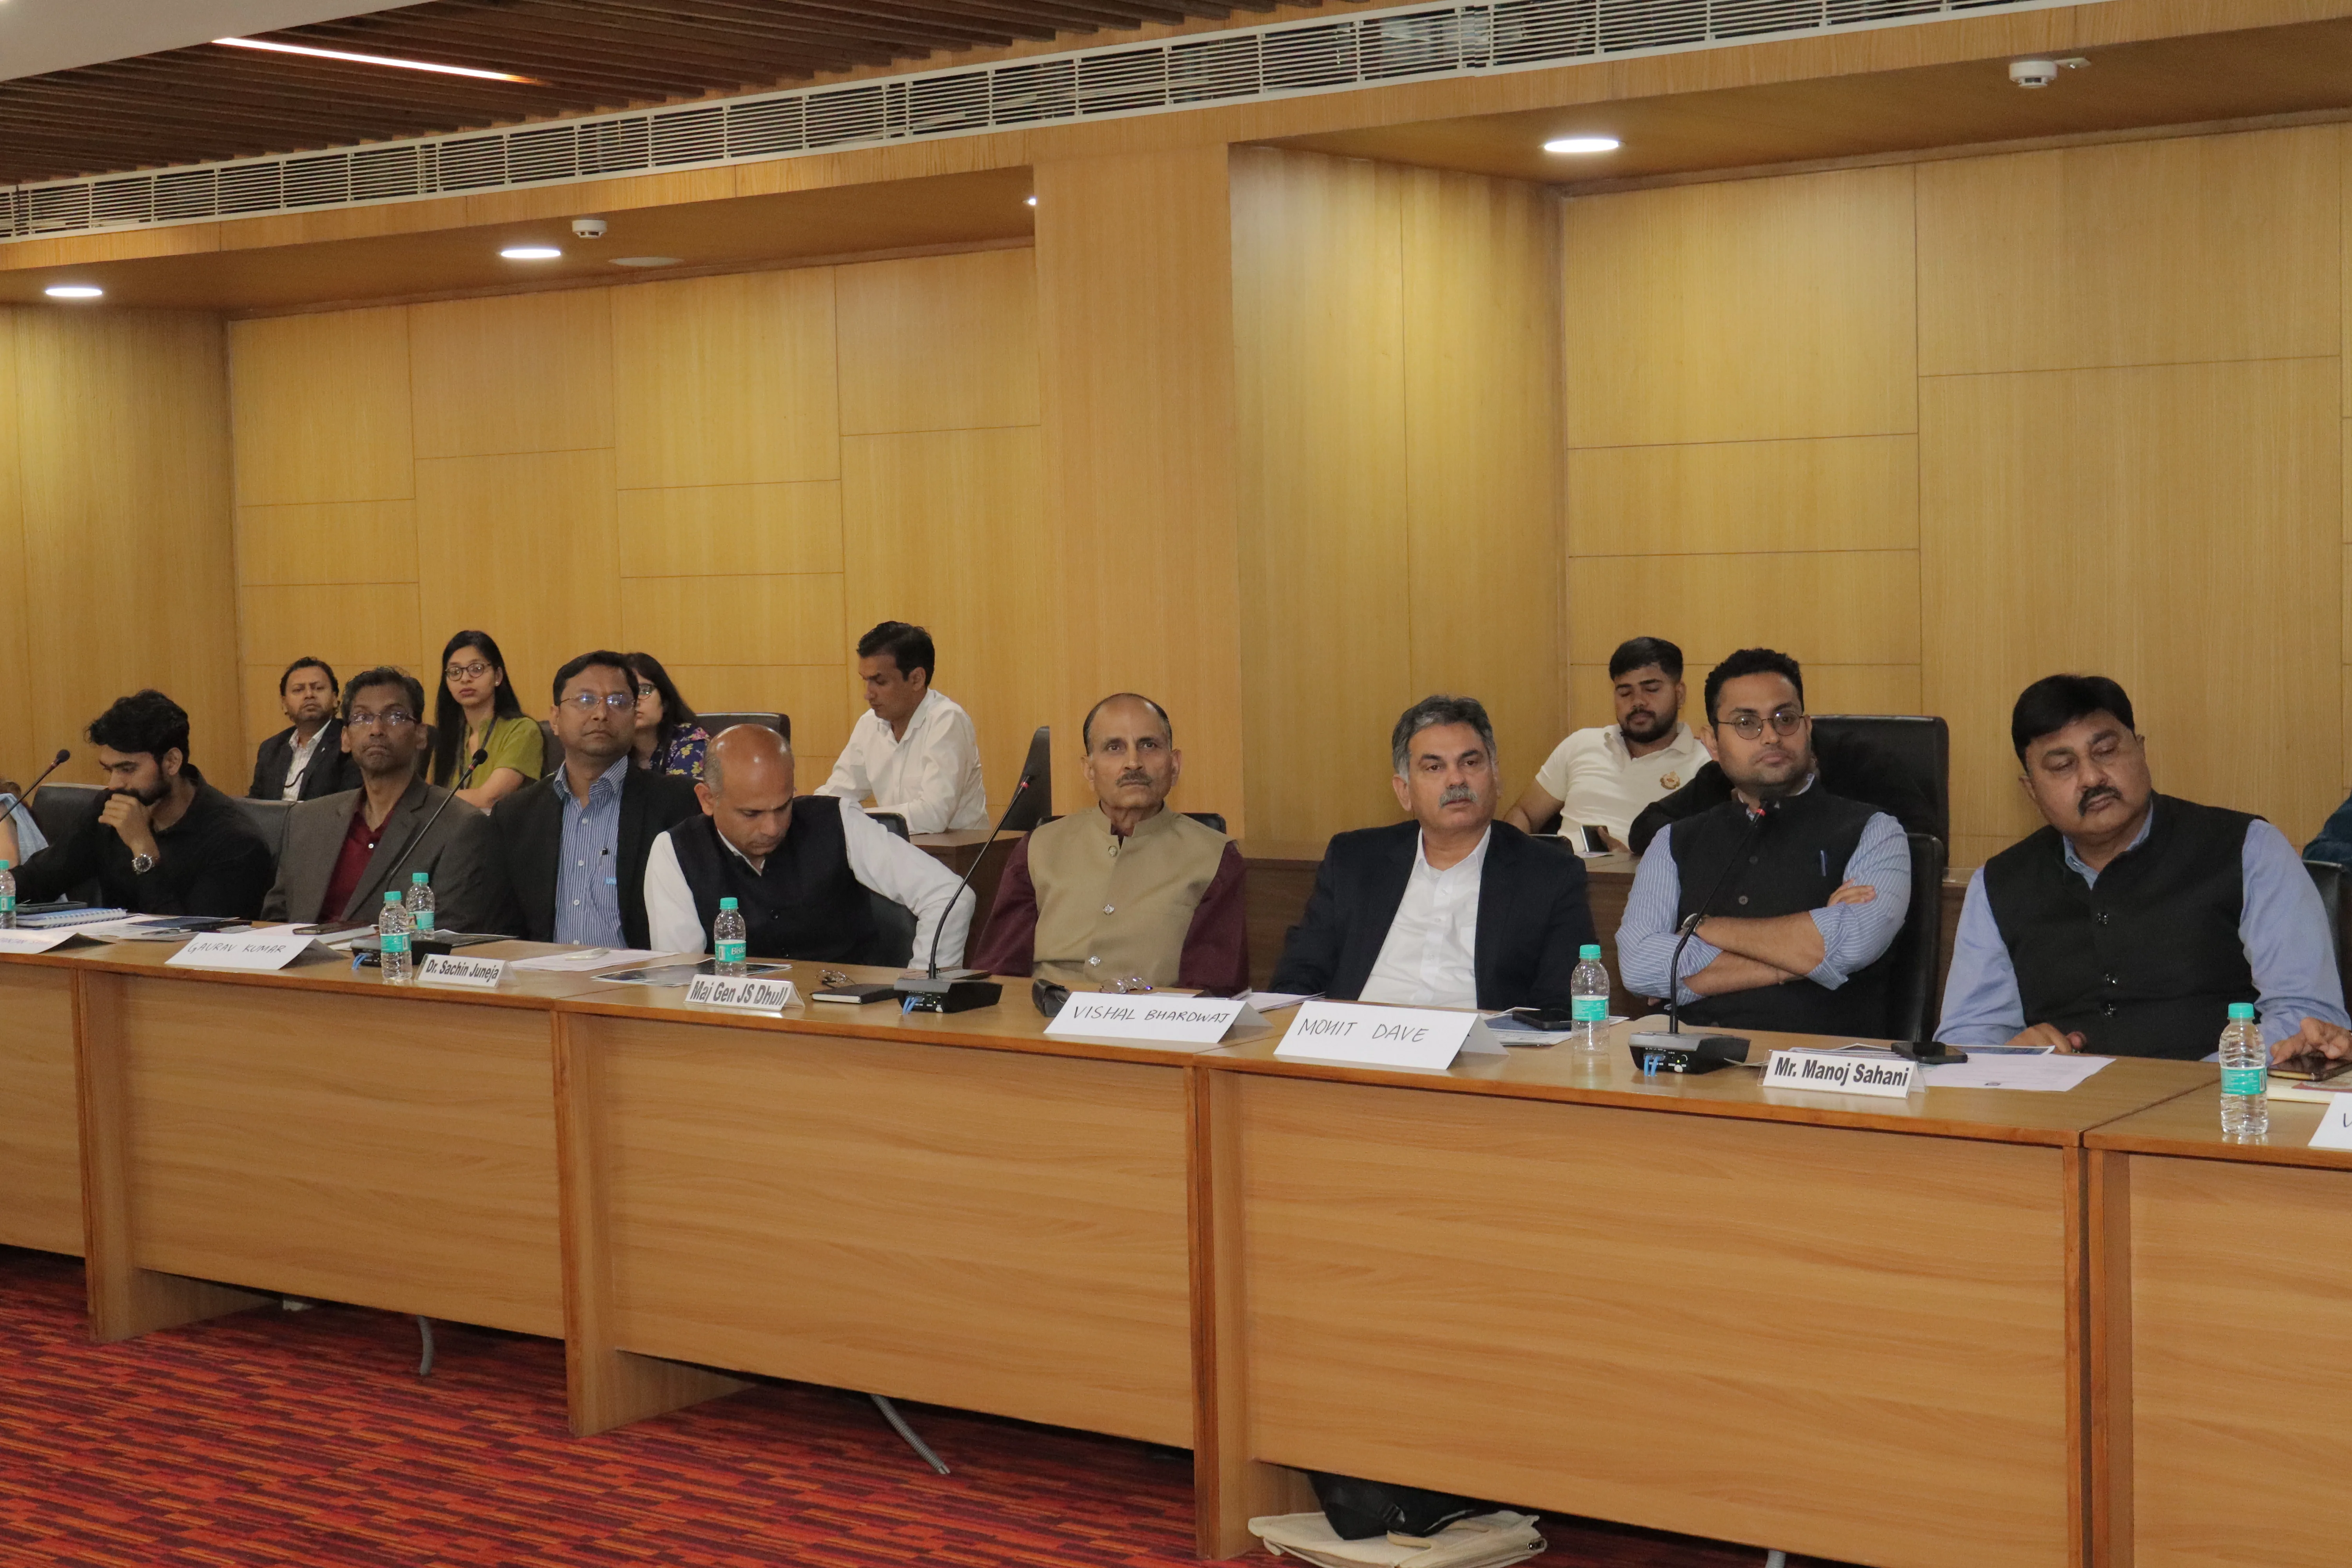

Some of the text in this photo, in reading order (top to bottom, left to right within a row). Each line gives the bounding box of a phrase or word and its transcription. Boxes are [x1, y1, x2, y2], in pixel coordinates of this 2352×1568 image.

[188, 942, 286, 954] GAURAV KUMAR
[425, 959, 499, 983] Dr. Sachin Juneja
[690, 981, 788, 1006] Maj Gen JS Dhull
[1073, 1005, 1230, 1024] VISHAL BHARDWAJ
[1298, 1018, 1429, 1042] MOHIT DAVE
[1774, 1057, 1910, 1087] Mr. Manoj Sahani
